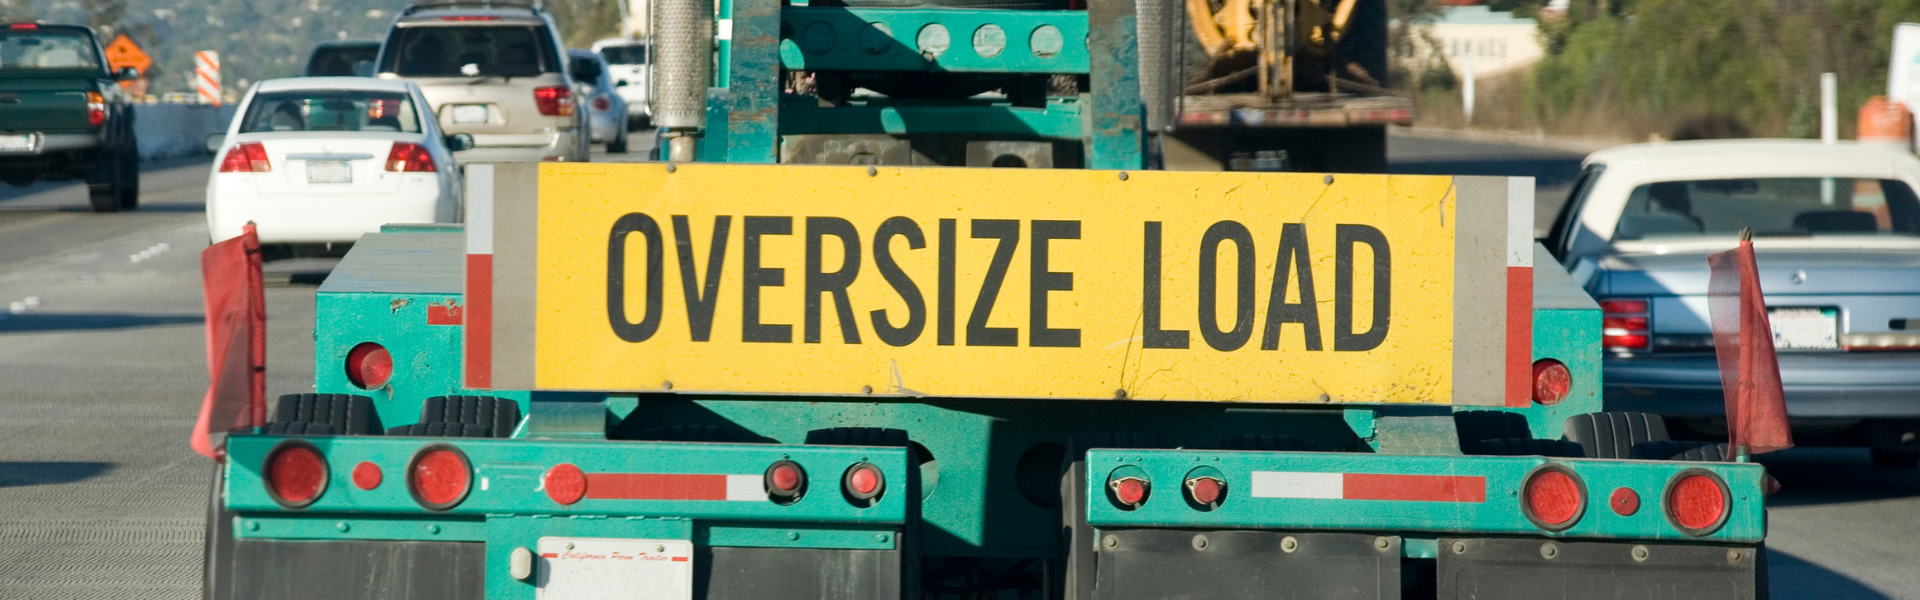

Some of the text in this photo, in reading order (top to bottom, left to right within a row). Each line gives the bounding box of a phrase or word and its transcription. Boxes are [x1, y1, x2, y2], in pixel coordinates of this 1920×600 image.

[608, 213, 1391, 352] OVERSIZE LOAD
[562, 550, 607, 562] California
[639, 552, 668, 561] Trailer
